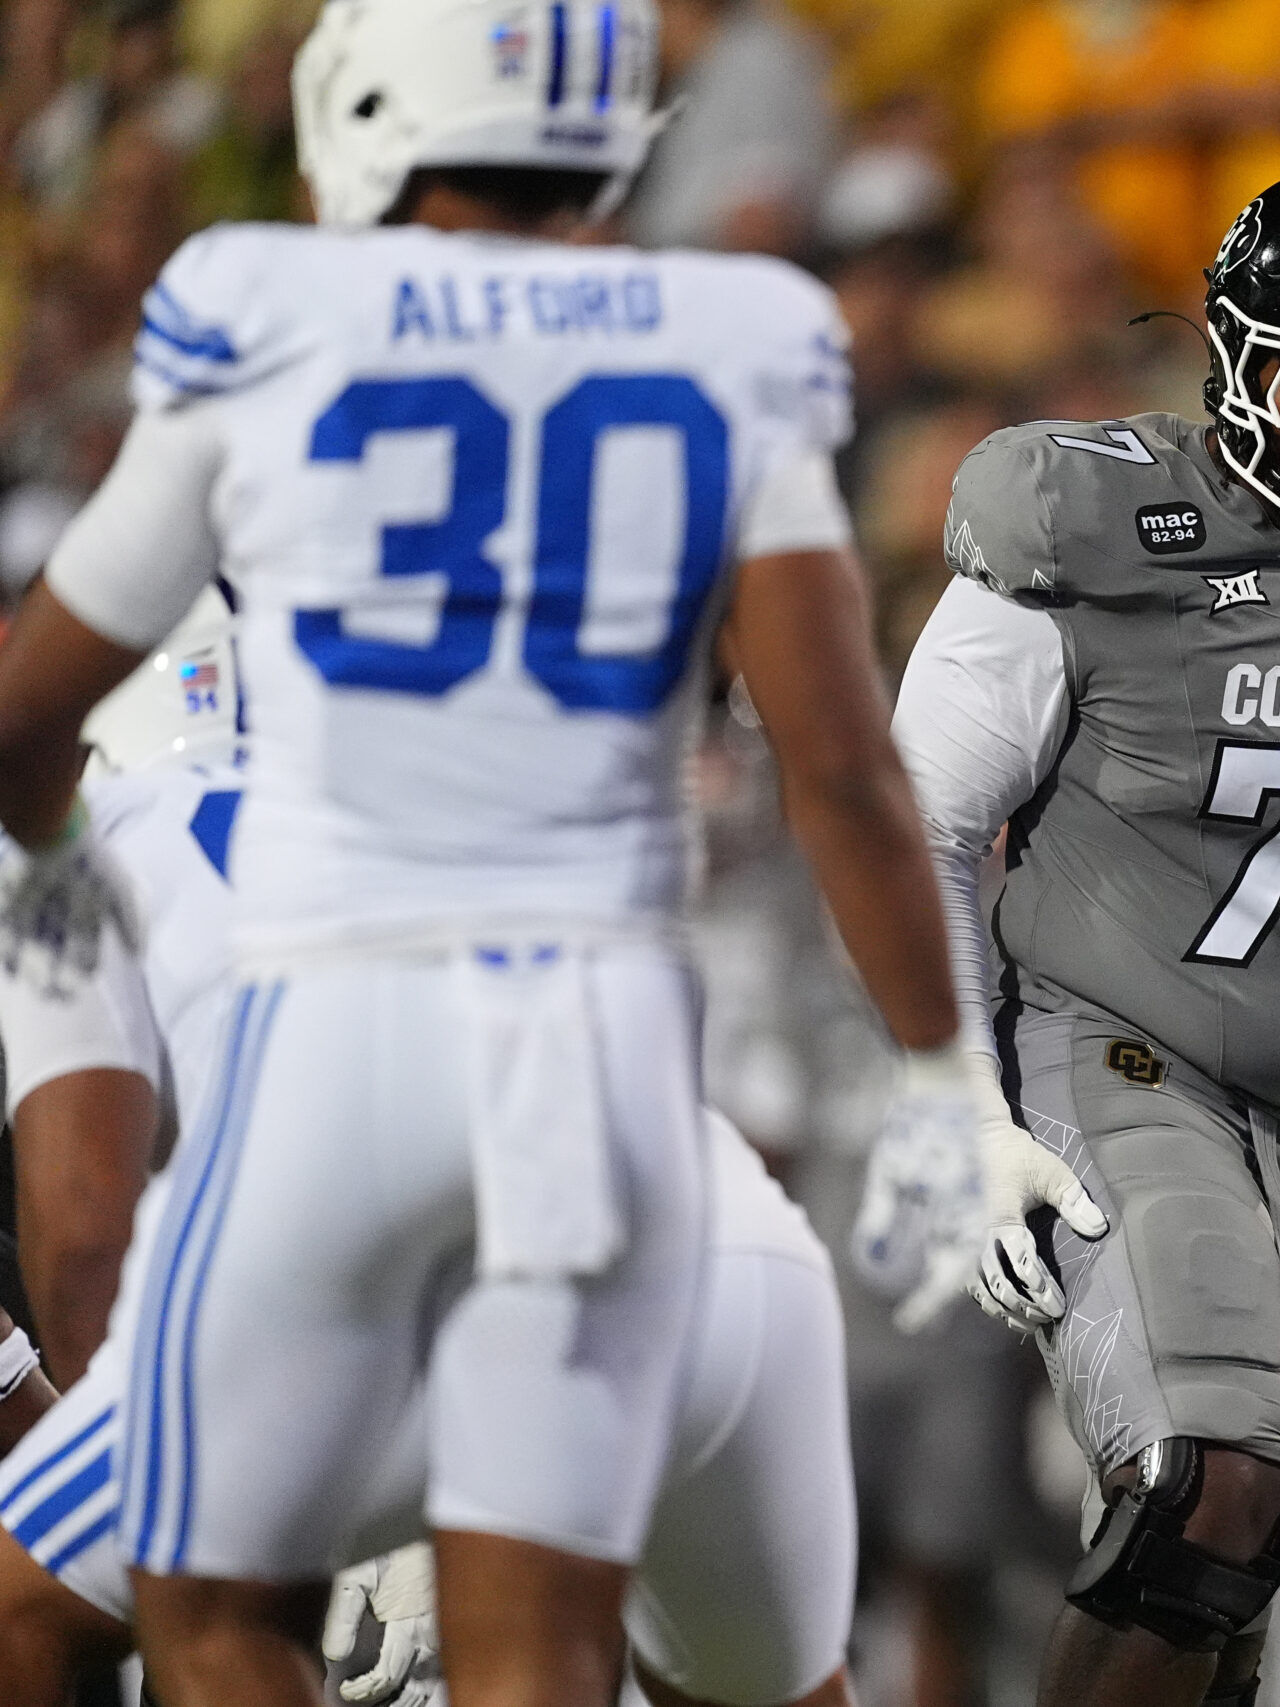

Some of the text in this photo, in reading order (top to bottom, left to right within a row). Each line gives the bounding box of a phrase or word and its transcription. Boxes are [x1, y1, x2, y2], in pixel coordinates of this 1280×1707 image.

[393, 273, 663, 340] ALFORD
[1141, 510, 1198, 530] mac
[1151, 529, 1195, 543] 82-94
[293, 374, 730, 717] 30
